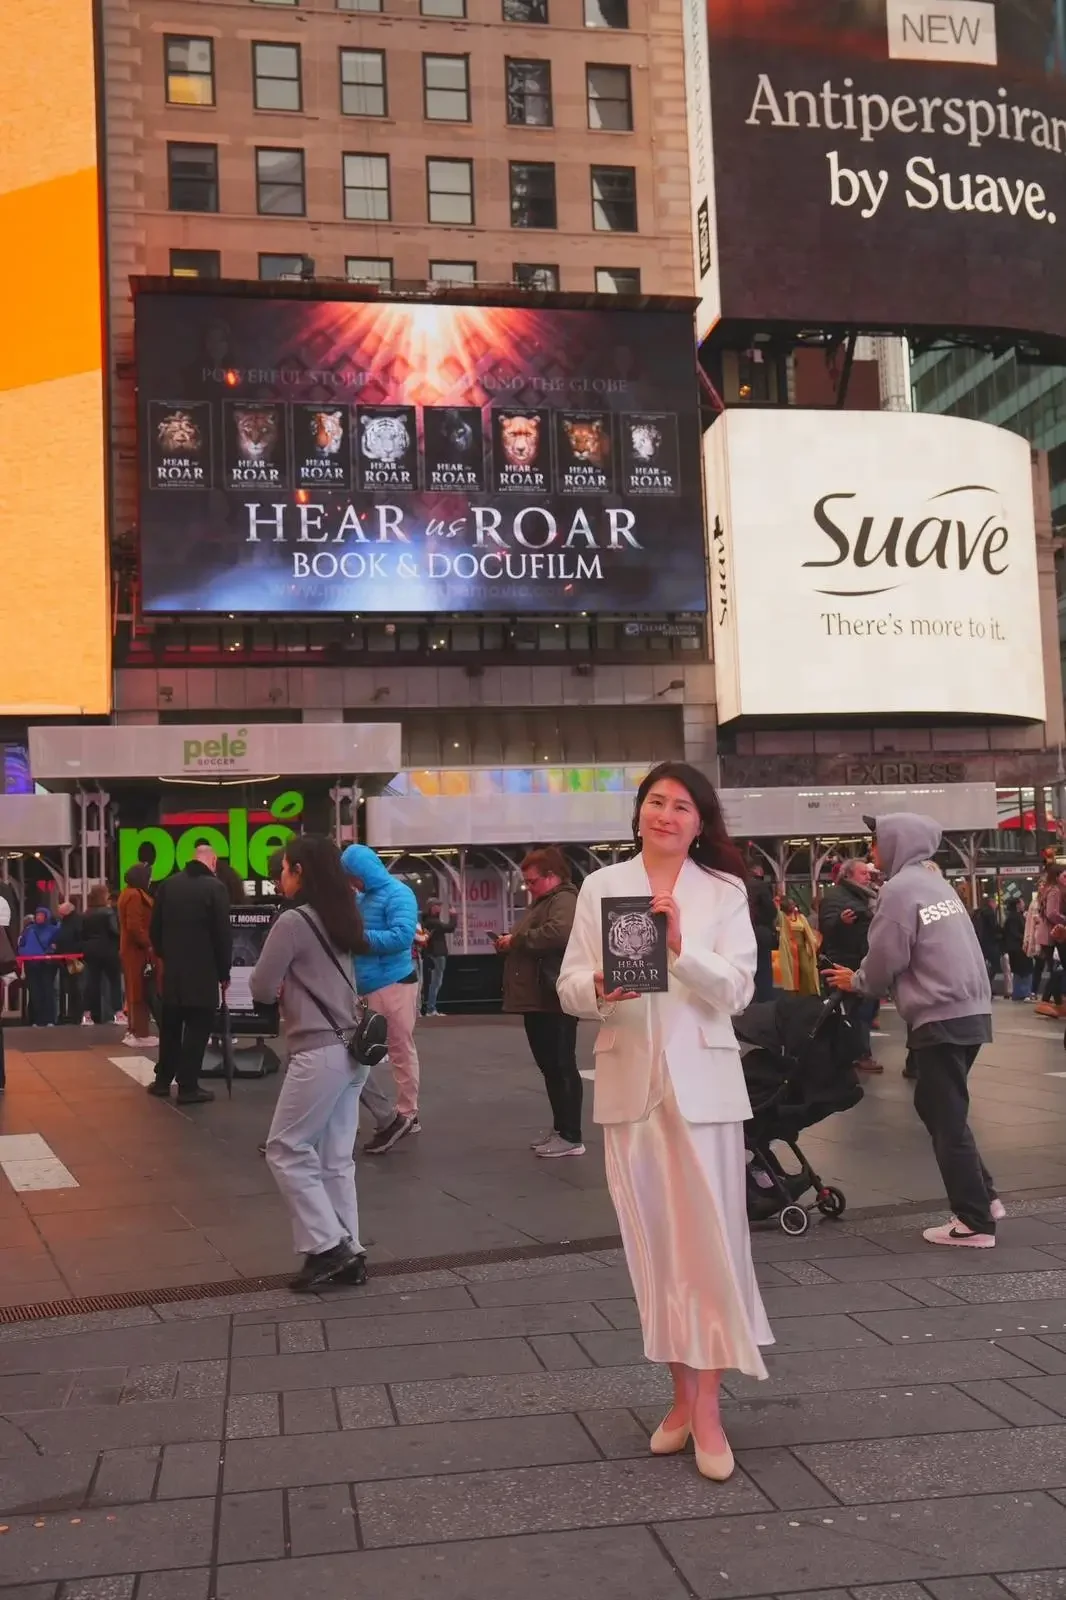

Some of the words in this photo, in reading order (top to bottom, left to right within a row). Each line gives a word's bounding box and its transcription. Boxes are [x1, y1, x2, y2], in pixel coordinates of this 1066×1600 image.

[902, 13, 980, 46] NEW
[826, 150, 889, 219] by
[905, 156, 1057, 224] Suave.
[699, 211, 710, 271] NEW
[569, 377, 629, 393] GLOBE
[163, 458, 190, 467] HEAR
[238, 460, 265, 468] HEAR
[305, 459, 331, 467] HEAR
[370, 462, 397, 470] HEAR
[437, 463, 464, 471] HEAR
[157, 467, 204, 480] ROAR
[232, 468, 280, 481] ROAR
[301, 467, 344, 479] ROAR
[569, 466, 594, 474] HEAR
[635, 467, 660, 475] HEAR
[365, 471, 411, 483] ROAR
[432, 471, 477, 484] ROAR
[500, 473, 544, 485] ROAR
[564, 475, 607, 486] ROAR
[631, 475, 673, 487] ROAR
[243, 502, 411, 544] HEAR
[425, 517, 467, 538] us
[471, 506, 646, 550] ROAR
[801, 491, 1010, 576] Suave
[292, 551, 389, 579] BOOK
[396, 552, 421, 579] &
[428, 552, 605, 580] DOCUFILM
[820, 612, 903, 636] There's
[911, 617, 963, 638] more
[969, 617, 986, 639] to
[990, 616, 1006, 641] it.
[846, 761, 966, 785] EXPRESS
[238, 914, 271, 923] MOMENT
[618, 960, 645, 969] HEAR
[612, 968, 659, 982] ROAR
